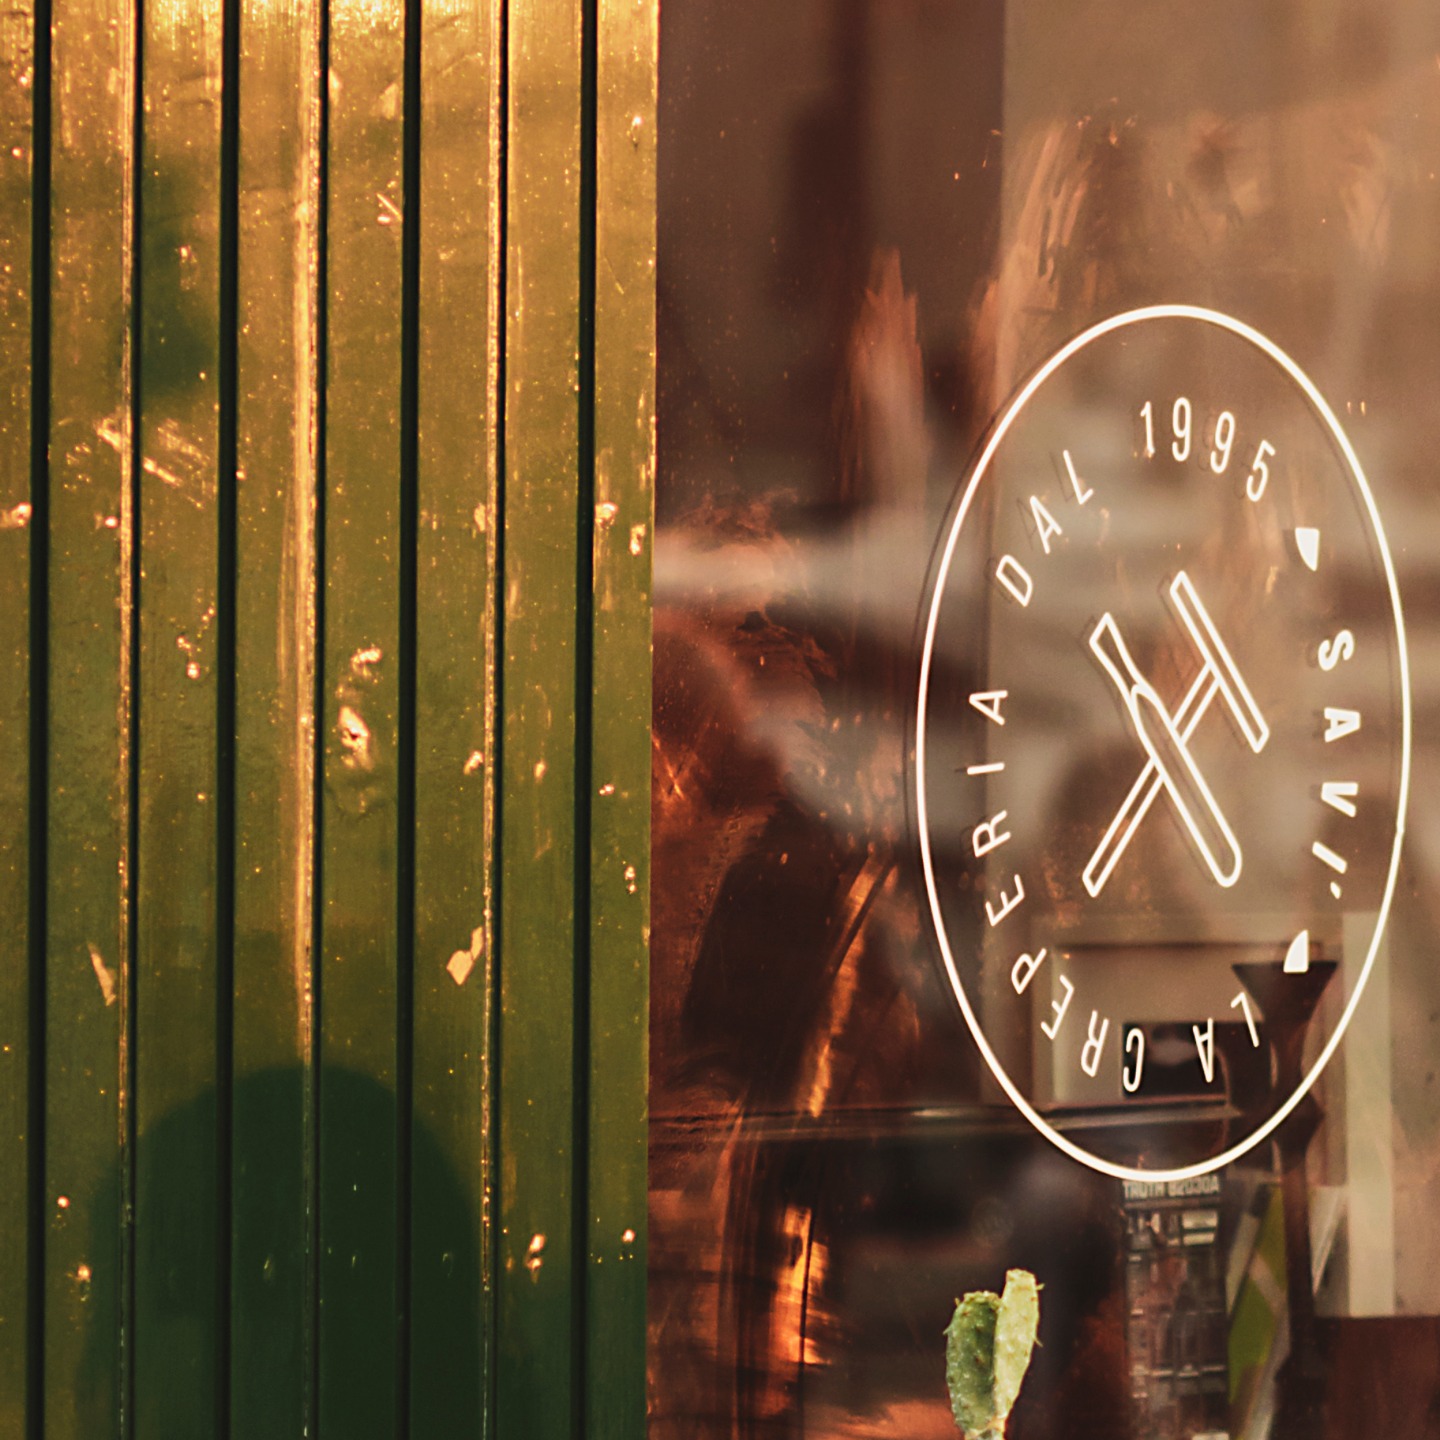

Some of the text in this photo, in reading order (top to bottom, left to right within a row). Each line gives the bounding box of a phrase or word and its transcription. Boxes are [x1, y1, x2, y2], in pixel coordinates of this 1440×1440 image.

[968, 396, 1276, 1093] LA CREPERIA DAL 1995
